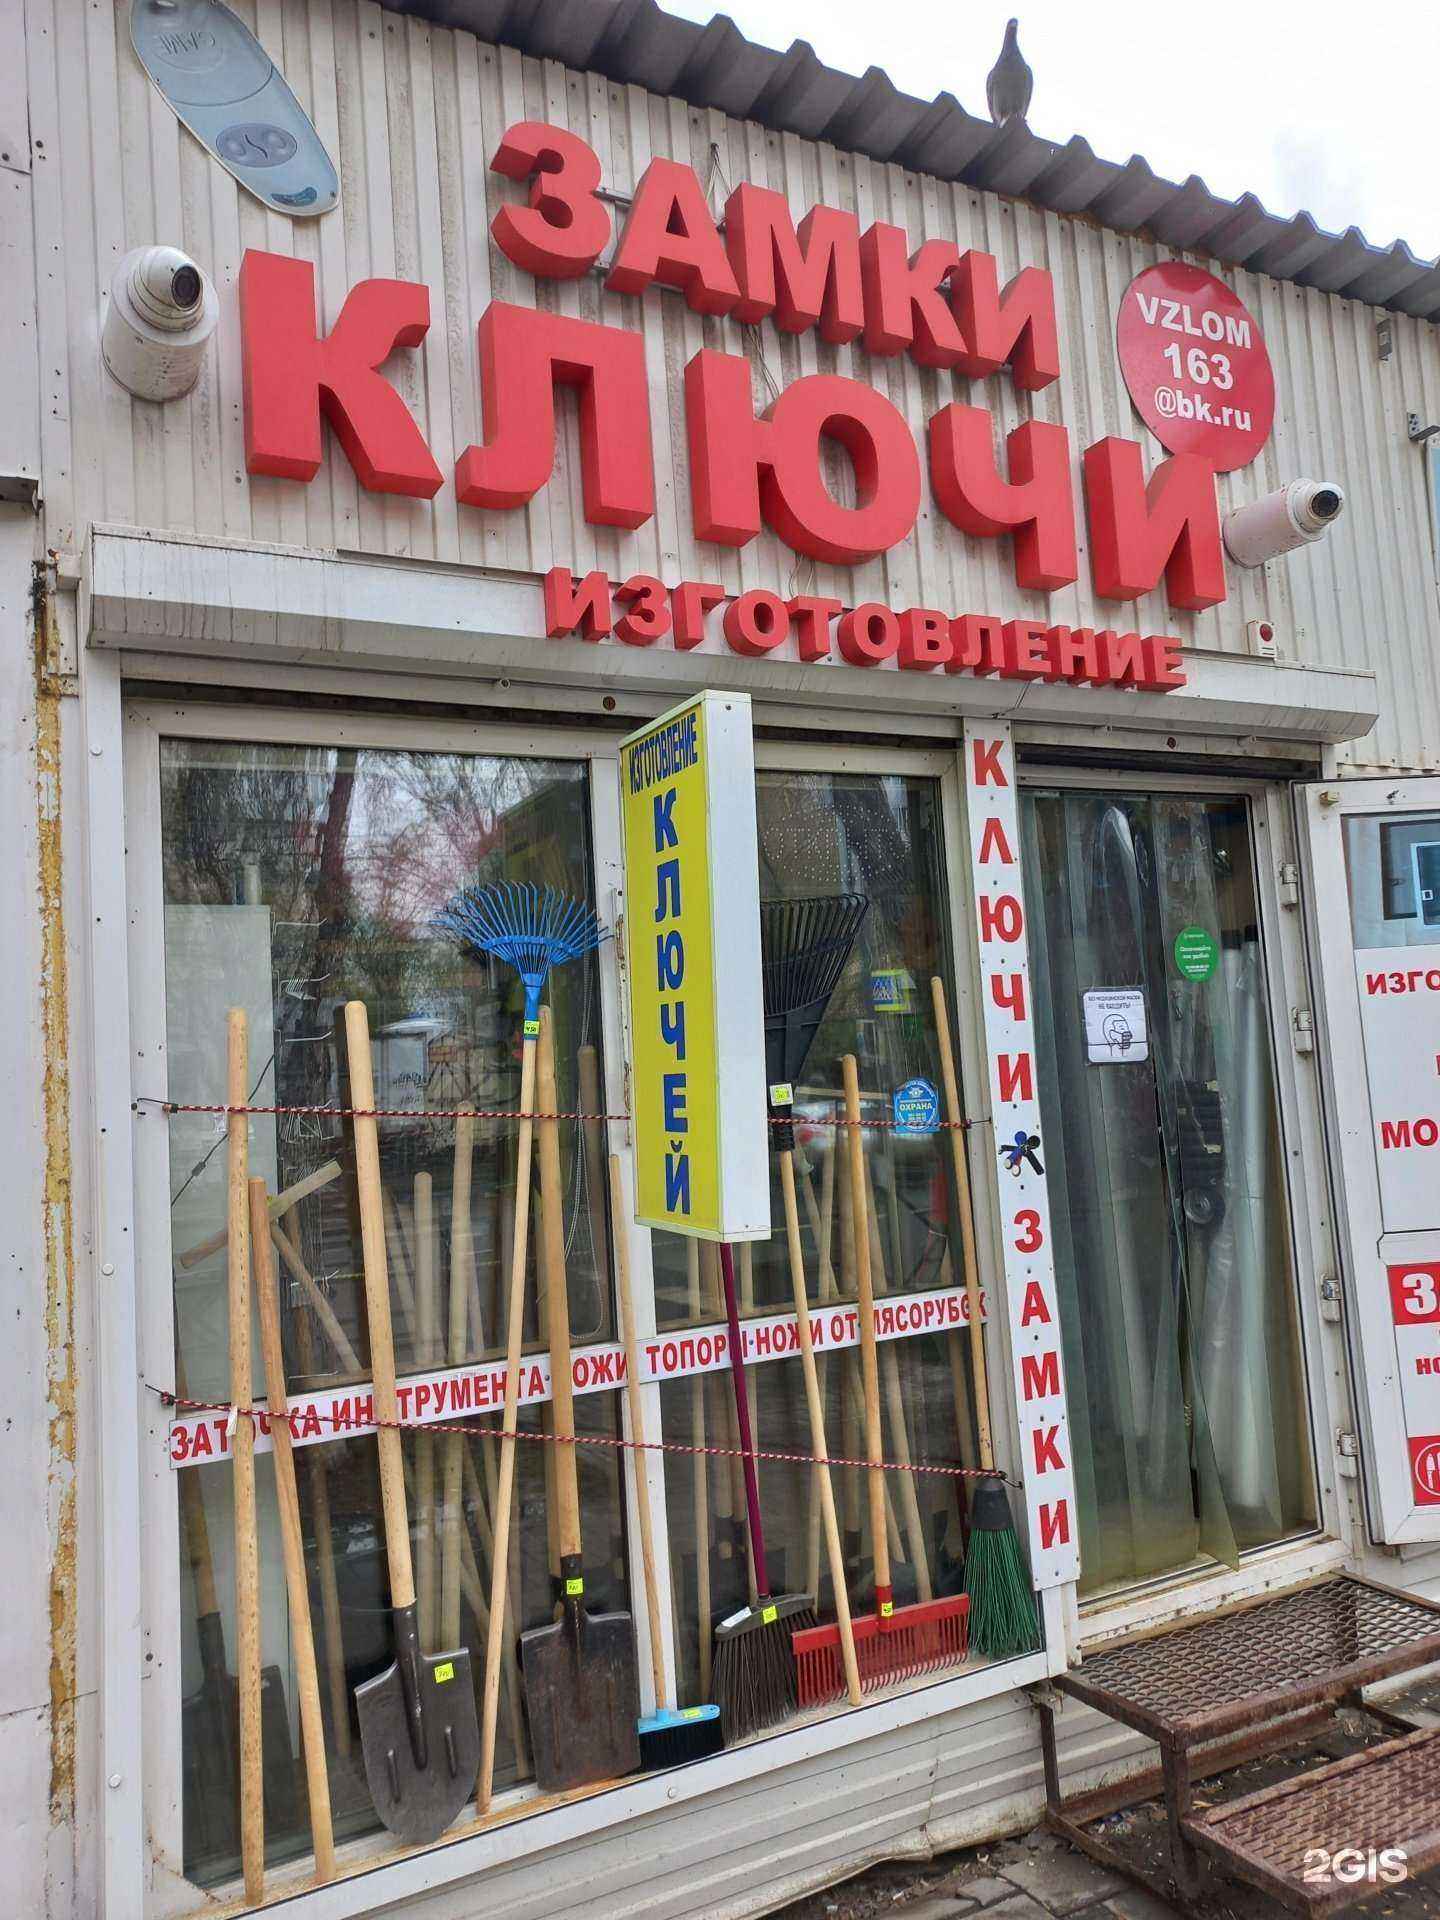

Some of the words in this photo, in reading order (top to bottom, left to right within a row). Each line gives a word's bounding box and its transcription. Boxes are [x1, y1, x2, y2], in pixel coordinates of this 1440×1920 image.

[489, 120, 1060, 392] ЗАМКИ
[1136, 293, 1251, 349] VZLOM
[1164, 342, 1234, 390] 163
[238, 248, 1227, 611] КЛЮЧИ
[1155, 386, 1252, 431] @bk.ru
[544, 566, 1188, 693] ИЗГОТОВЛЕНИЕ
[629, 712, 698, 795] ИЗГОТОВЛЕНИЕ
[654, 787, 691, 1215] КЛЮЧЕЙ
[899, 1102, 932, 1111] ОХРАНА
[972, 738, 1033, 1103] КЛЮЧИ
[1013, 1208, 1071, 1551] ЗАМКИ
[332, 1365, 545, 1433] ИНТРУМЕНТА
[566, 1351, 628, 1388] ОЖИ
[830, 1312, 857, 1343] ОТ
